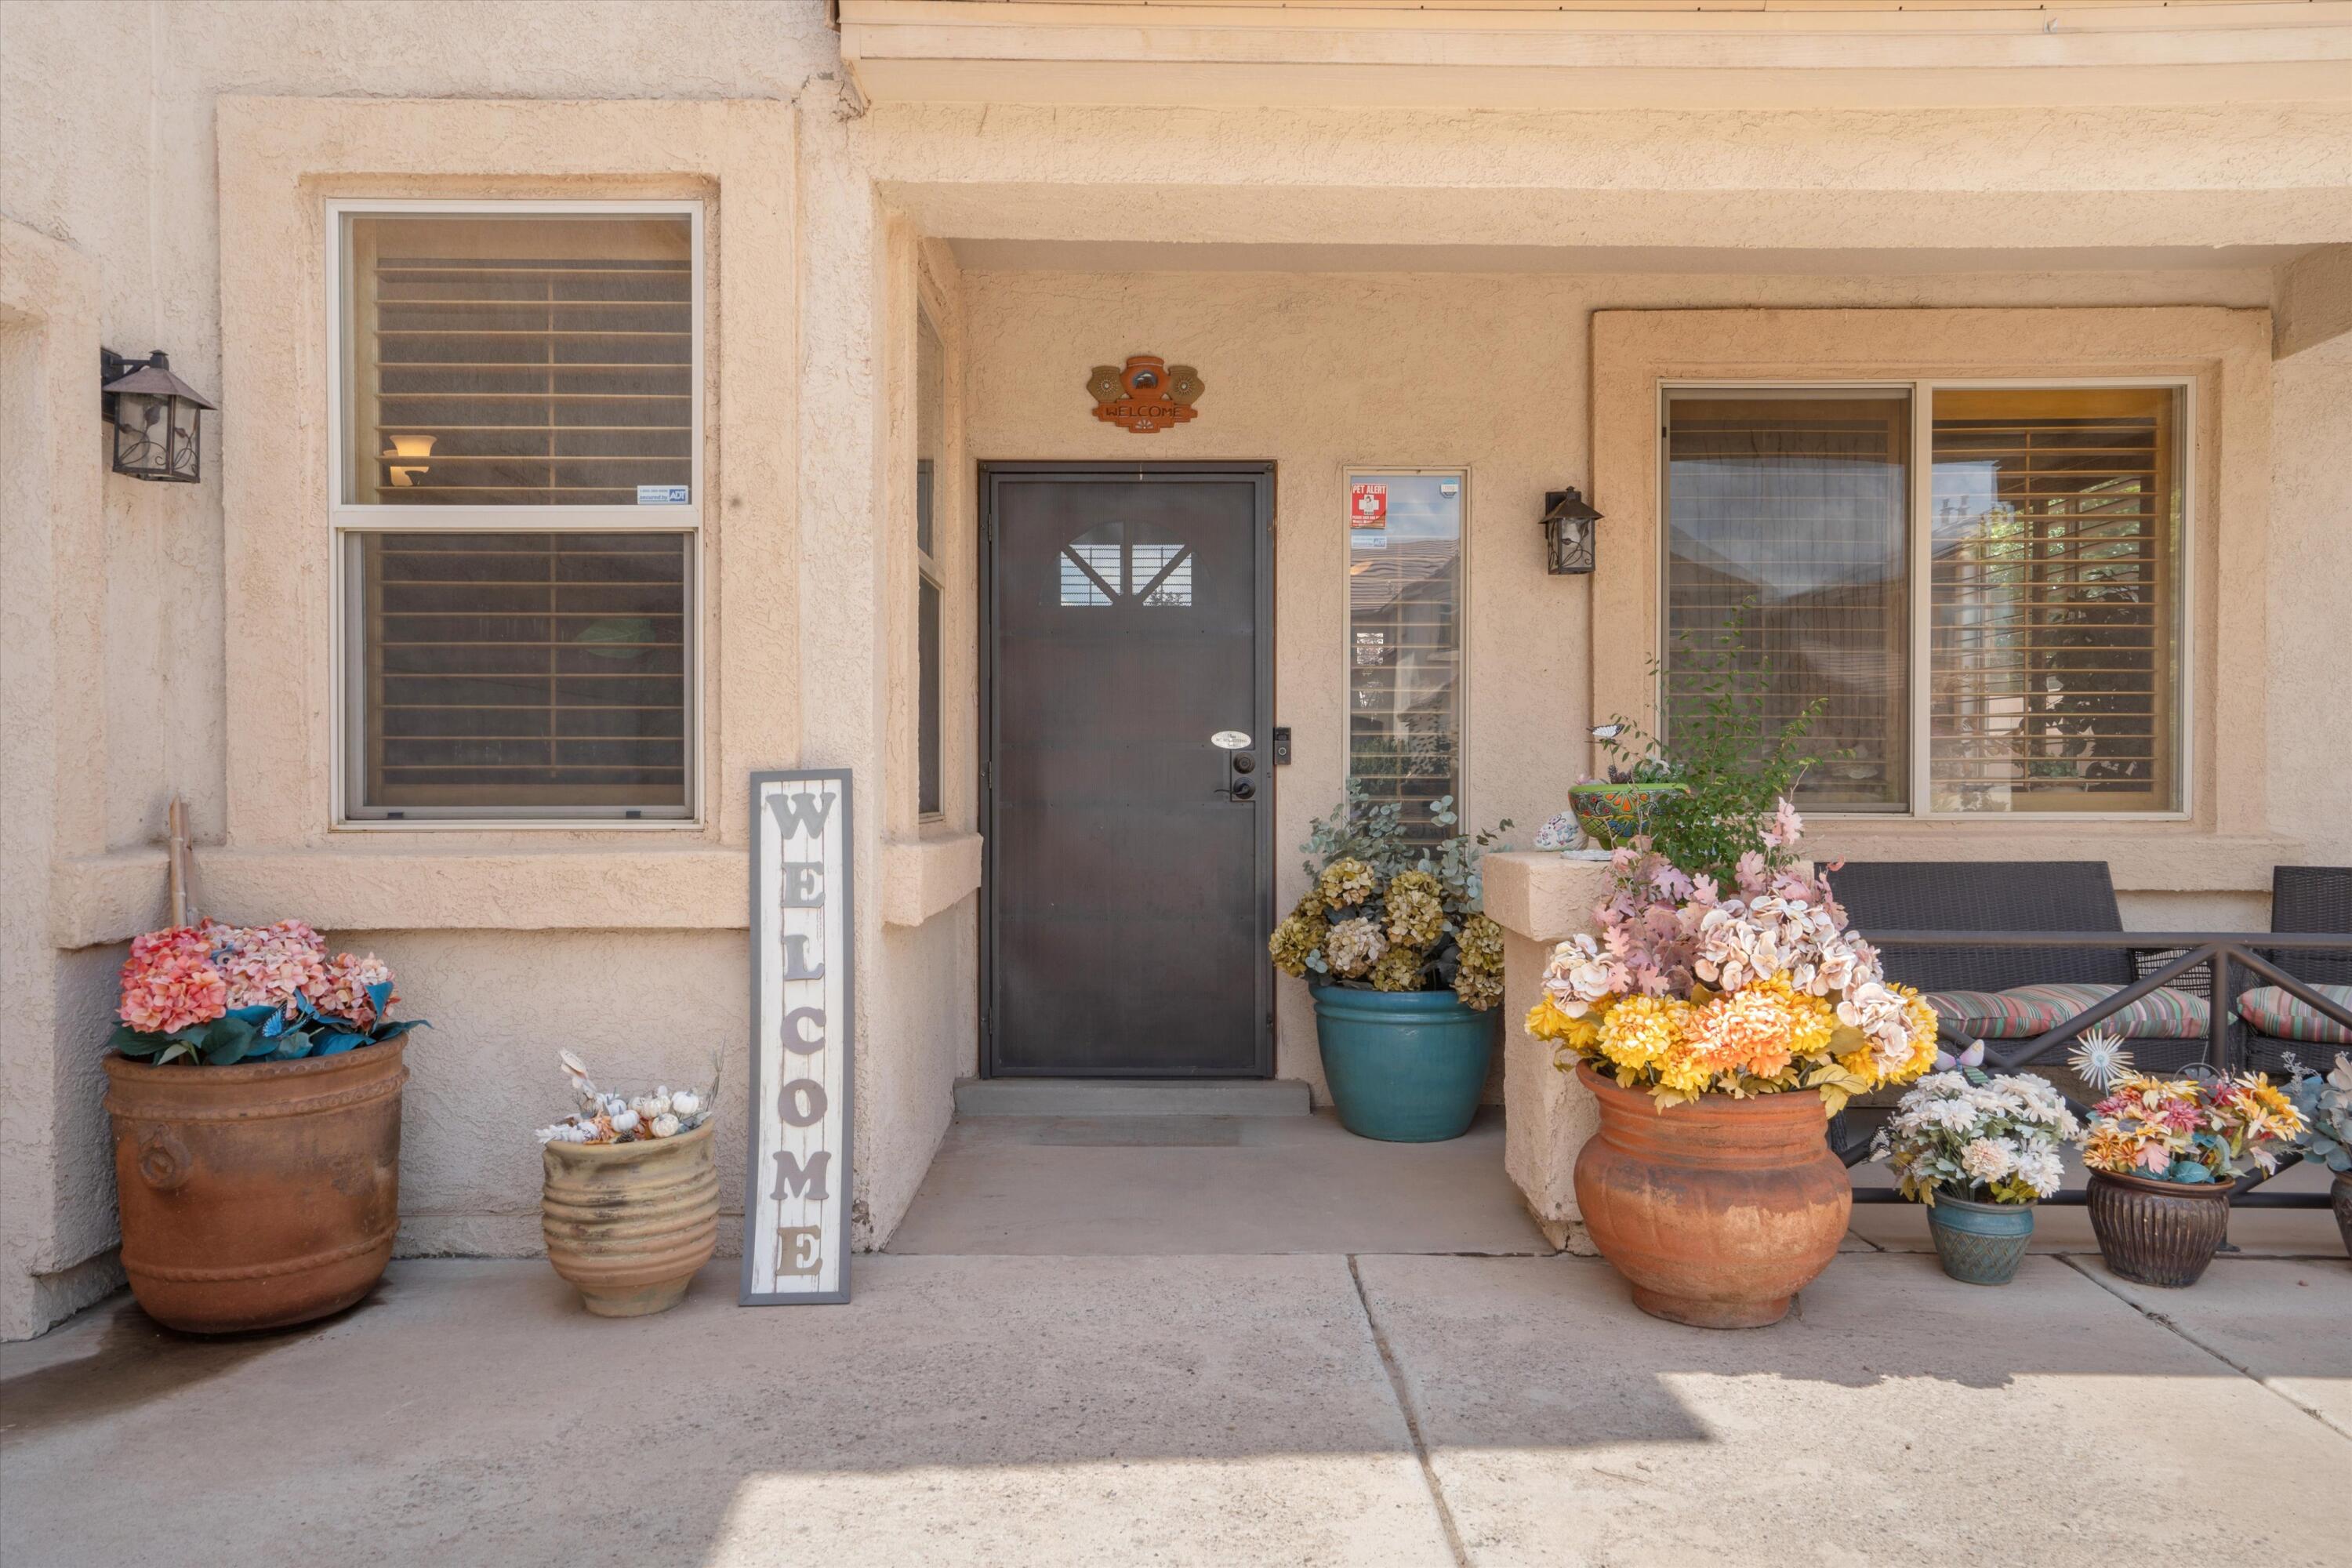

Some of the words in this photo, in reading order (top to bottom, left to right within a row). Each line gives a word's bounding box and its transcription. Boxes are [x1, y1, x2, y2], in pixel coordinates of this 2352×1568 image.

[1105, 405, 1183, 417] WELCOME
[670, 490, 686, 500] ADT
[1353, 485, 1365, 494] PET
[1367, 485, 1386, 495] ALERT
[764, 792, 837, 1277] WELCOME
